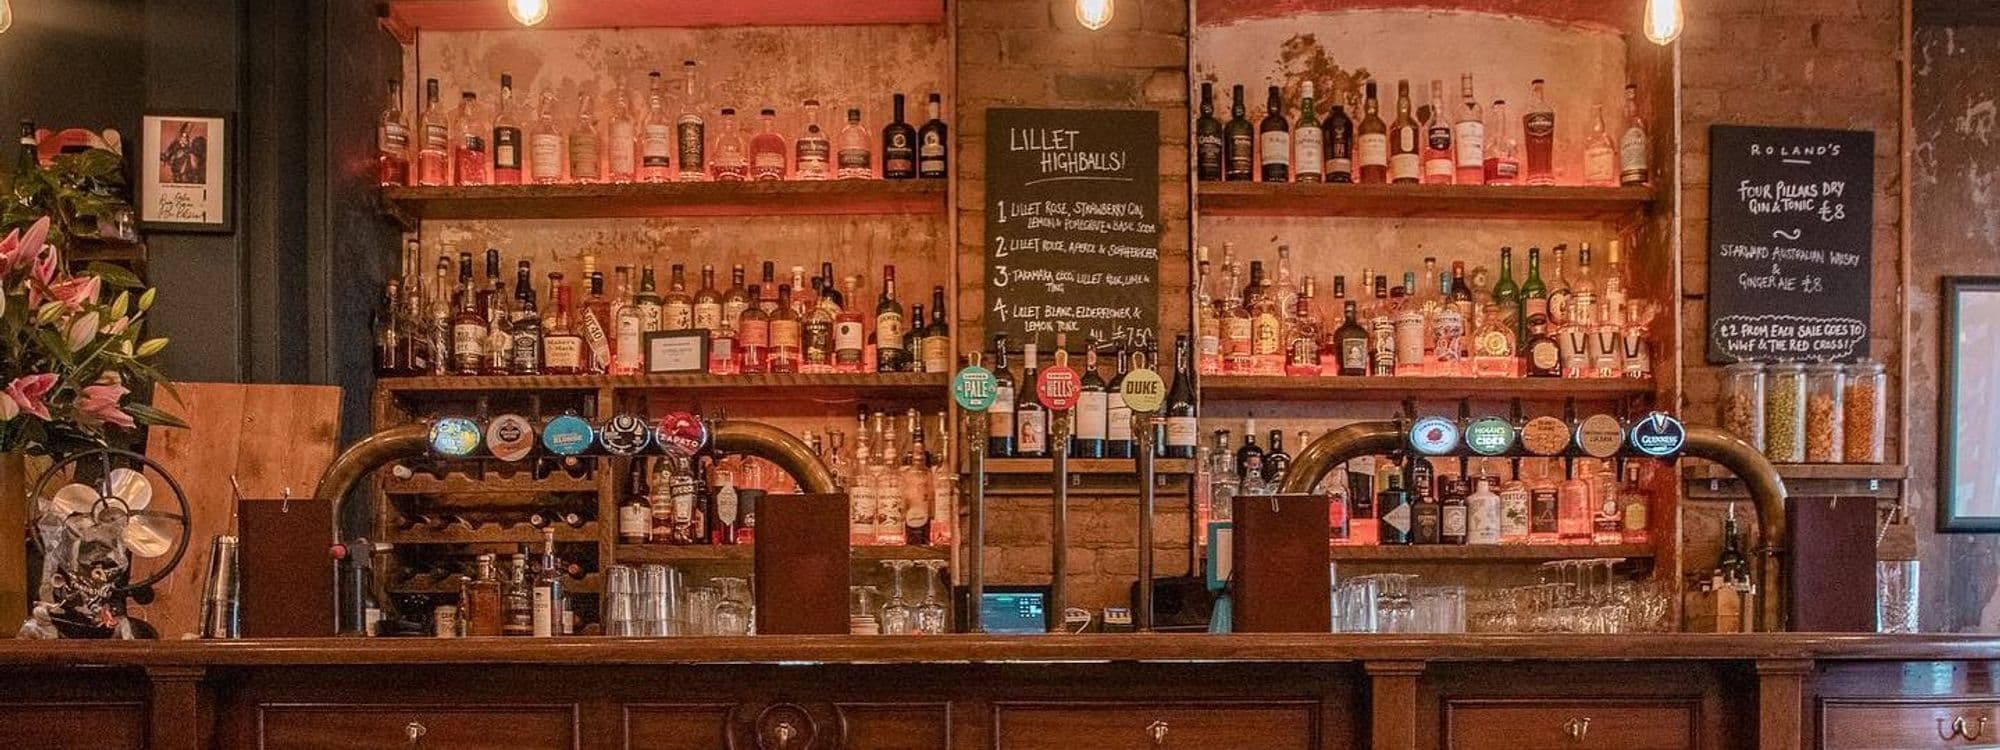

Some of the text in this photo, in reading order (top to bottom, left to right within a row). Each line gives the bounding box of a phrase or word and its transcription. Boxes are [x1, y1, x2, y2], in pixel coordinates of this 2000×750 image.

[1010, 128, 1080, 151] LILLET
[1751, 143, 1841, 156] ROLAND'S
[1040, 151, 1126, 173] HIGHBALLS!
[1737, 180, 1845, 202] FOUR PILLARS DRY
[1011, 202, 1042, 217] LILLET
[1749, 198, 1814, 215] GIN & TONIC
[1817, 200, 1845, 222] £8
[1010, 238, 1040, 252] LILLET
[1772, 246, 1825, 263] AUSTRALIAN
[1771, 263, 1781, 275] &
[1076, 272, 1104, 284] LILLET
[1738, 273, 1823, 293] GINGER ALE £8
[1013, 305, 1041, 319] LILLET
[1024, 321, 1054, 332] LEMON
[1741, 325, 1769, 338] FROM
[1770, 324, 1794, 337] EACH
[1797, 324, 1823, 338] SALE
[1824, 324, 1848, 336] GOES
[1849, 324, 1862, 336] TO
[1728, 339, 1758, 351] WWF
[1766, 339, 1787, 352] THE
[1789, 339, 1810, 351] RED
[963, 380, 988, 398] PALE
[1046, 380, 1073, 398] HELLS
[1126, 381, 1157, 395] DUKE
